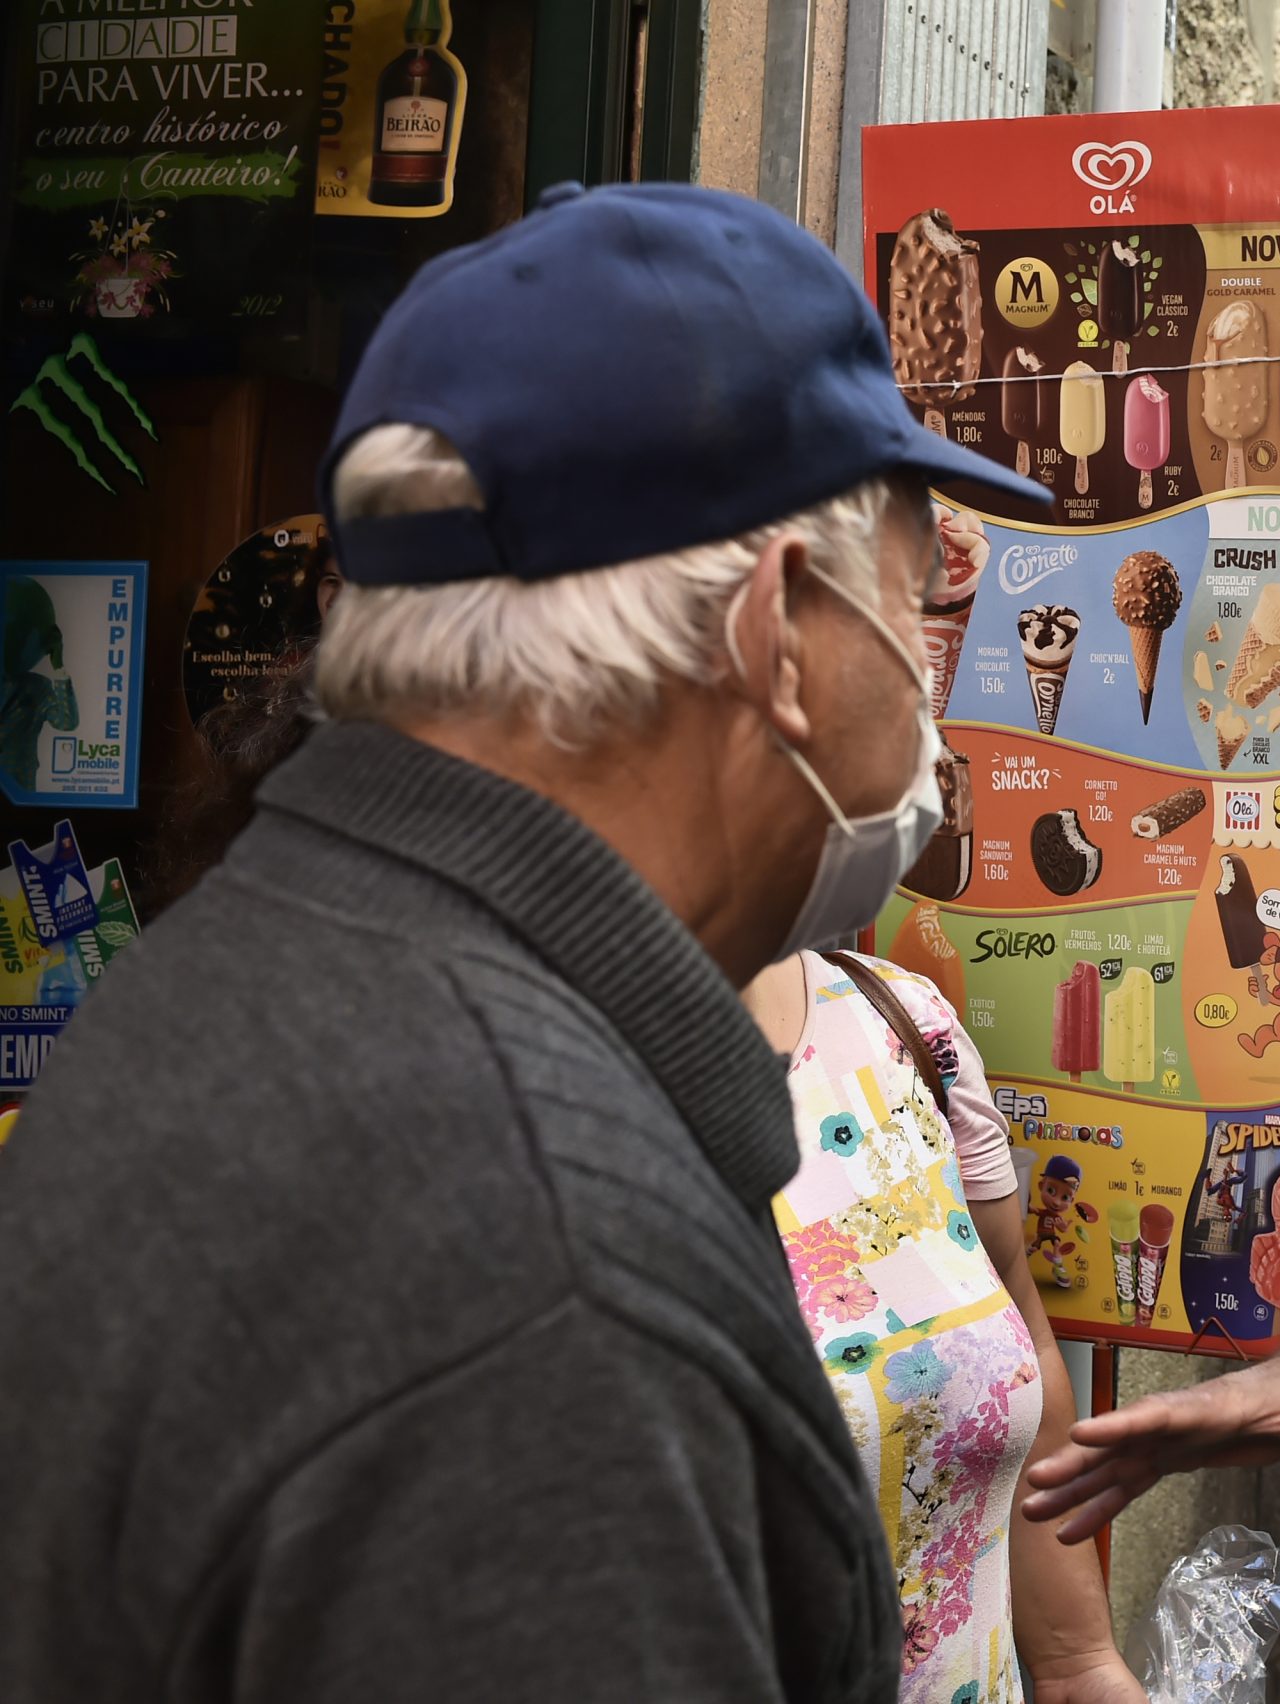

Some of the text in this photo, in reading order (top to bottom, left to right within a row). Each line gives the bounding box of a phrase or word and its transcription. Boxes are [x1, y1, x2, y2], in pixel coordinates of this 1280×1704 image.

[38, 19, 230, 60] CIDADE
[37, 62, 303, 104] PARA VIVER...
[35, 105, 287, 147] centro histórico
[386, 116, 441, 132] BEIRÃO
[36, 145, 298, 192] o seu Canteiro!
[1089, 190, 1135, 214] OLÁ
[1221, 278, 1262, 287] DOUBLE
[1207, 287, 1276, 296] GOLD CARAMEL
[1161, 295, 1183, 304] VEGAN
[1005, 303, 1050, 313] MAGNUM
[1157, 303, 1188, 316] CLÁSSICO
[1167, 321, 1179, 337] 2€
[956, 427, 982, 443] 1,80€
[1036, 448, 1063, 465] 1,80€
[1210, 445, 1222, 461] 2€
[1164, 466, 1182, 476] RUBY
[1167, 480, 1179, 496] 2€
[1064, 499, 1100, 509] CHOCOLATE
[1069, 509, 1094, 519] BRANCO
[1214, 548, 1276, 571] CRUSH
[998, 544, 1078, 595] Cornetto
[1206, 576, 1257, 585] CHOCOLATE
[1213, 586, 1249, 596] BRANCO
[1218, 602, 1242, 619] 1,80€
[105, 579, 128, 739] EMPURRE
[192, 651, 241, 663] Escolha
[977, 647, 1008, 657] MORANGO
[210, 664, 258, 677] escolha
[975, 661, 1010, 672] CHOCOLATE
[1103, 668, 1115, 684] 2€
[981, 677, 1005, 693] 1,50€
[78, 740, 120, 759] Lyca
[77, 758, 119, 769] mobile
[1021, 756, 1036, 768] UM
[1253, 753, 1270, 765] XXL
[992, 769, 1050, 790] SNACK?
[1085, 780, 1118, 790] CORNETTO
[1095, 791, 1107, 801] GO!
[1088, 805, 1113, 822] 1,20€
[1232, 800, 1253, 816] Olá
[983, 840, 1010, 850] MAGNUM
[1156, 844, 1184, 855] MAGNUM
[980, 850, 1013, 861] SANDWICH
[1144, 855, 1172, 865] CARAMEL
[1180, 856, 1197, 866] NUTS
[983, 864, 1009, 881] 1,60€
[1157, 868, 1182, 885] 1,20€
[22, 864, 59, 938] SMINT
[1266, 905, 1277, 918] de
[1071, 929, 1096, 940] FRUTOS
[1144, 934, 1164, 944] LIMÃO
[1064, 940, 1102, 951] VERMELHOS
[1108, 934, 1132, 951] 1,20€
[1137, 945, 1171, 955] E HORTELÃ
[1101, 962, 1113, 978] 52
[1154, 967, 1164, 981] 61
[969, 998, 996, 1008] EXÓTICO
[21, 1007, 69, 1021] SMINT.
[1203, 1003, 1230, 1019] 0,80€
[972, 1011, 995, 1027] 1,50€
[1108, 1180, 1127, 1190] LIMÃO
[1135, 1181, 1144, 1196] 1€
[1151, 1185, 1182, 1196] MORANGO
[1214, 1292, 1239, 1311] 1,50€
